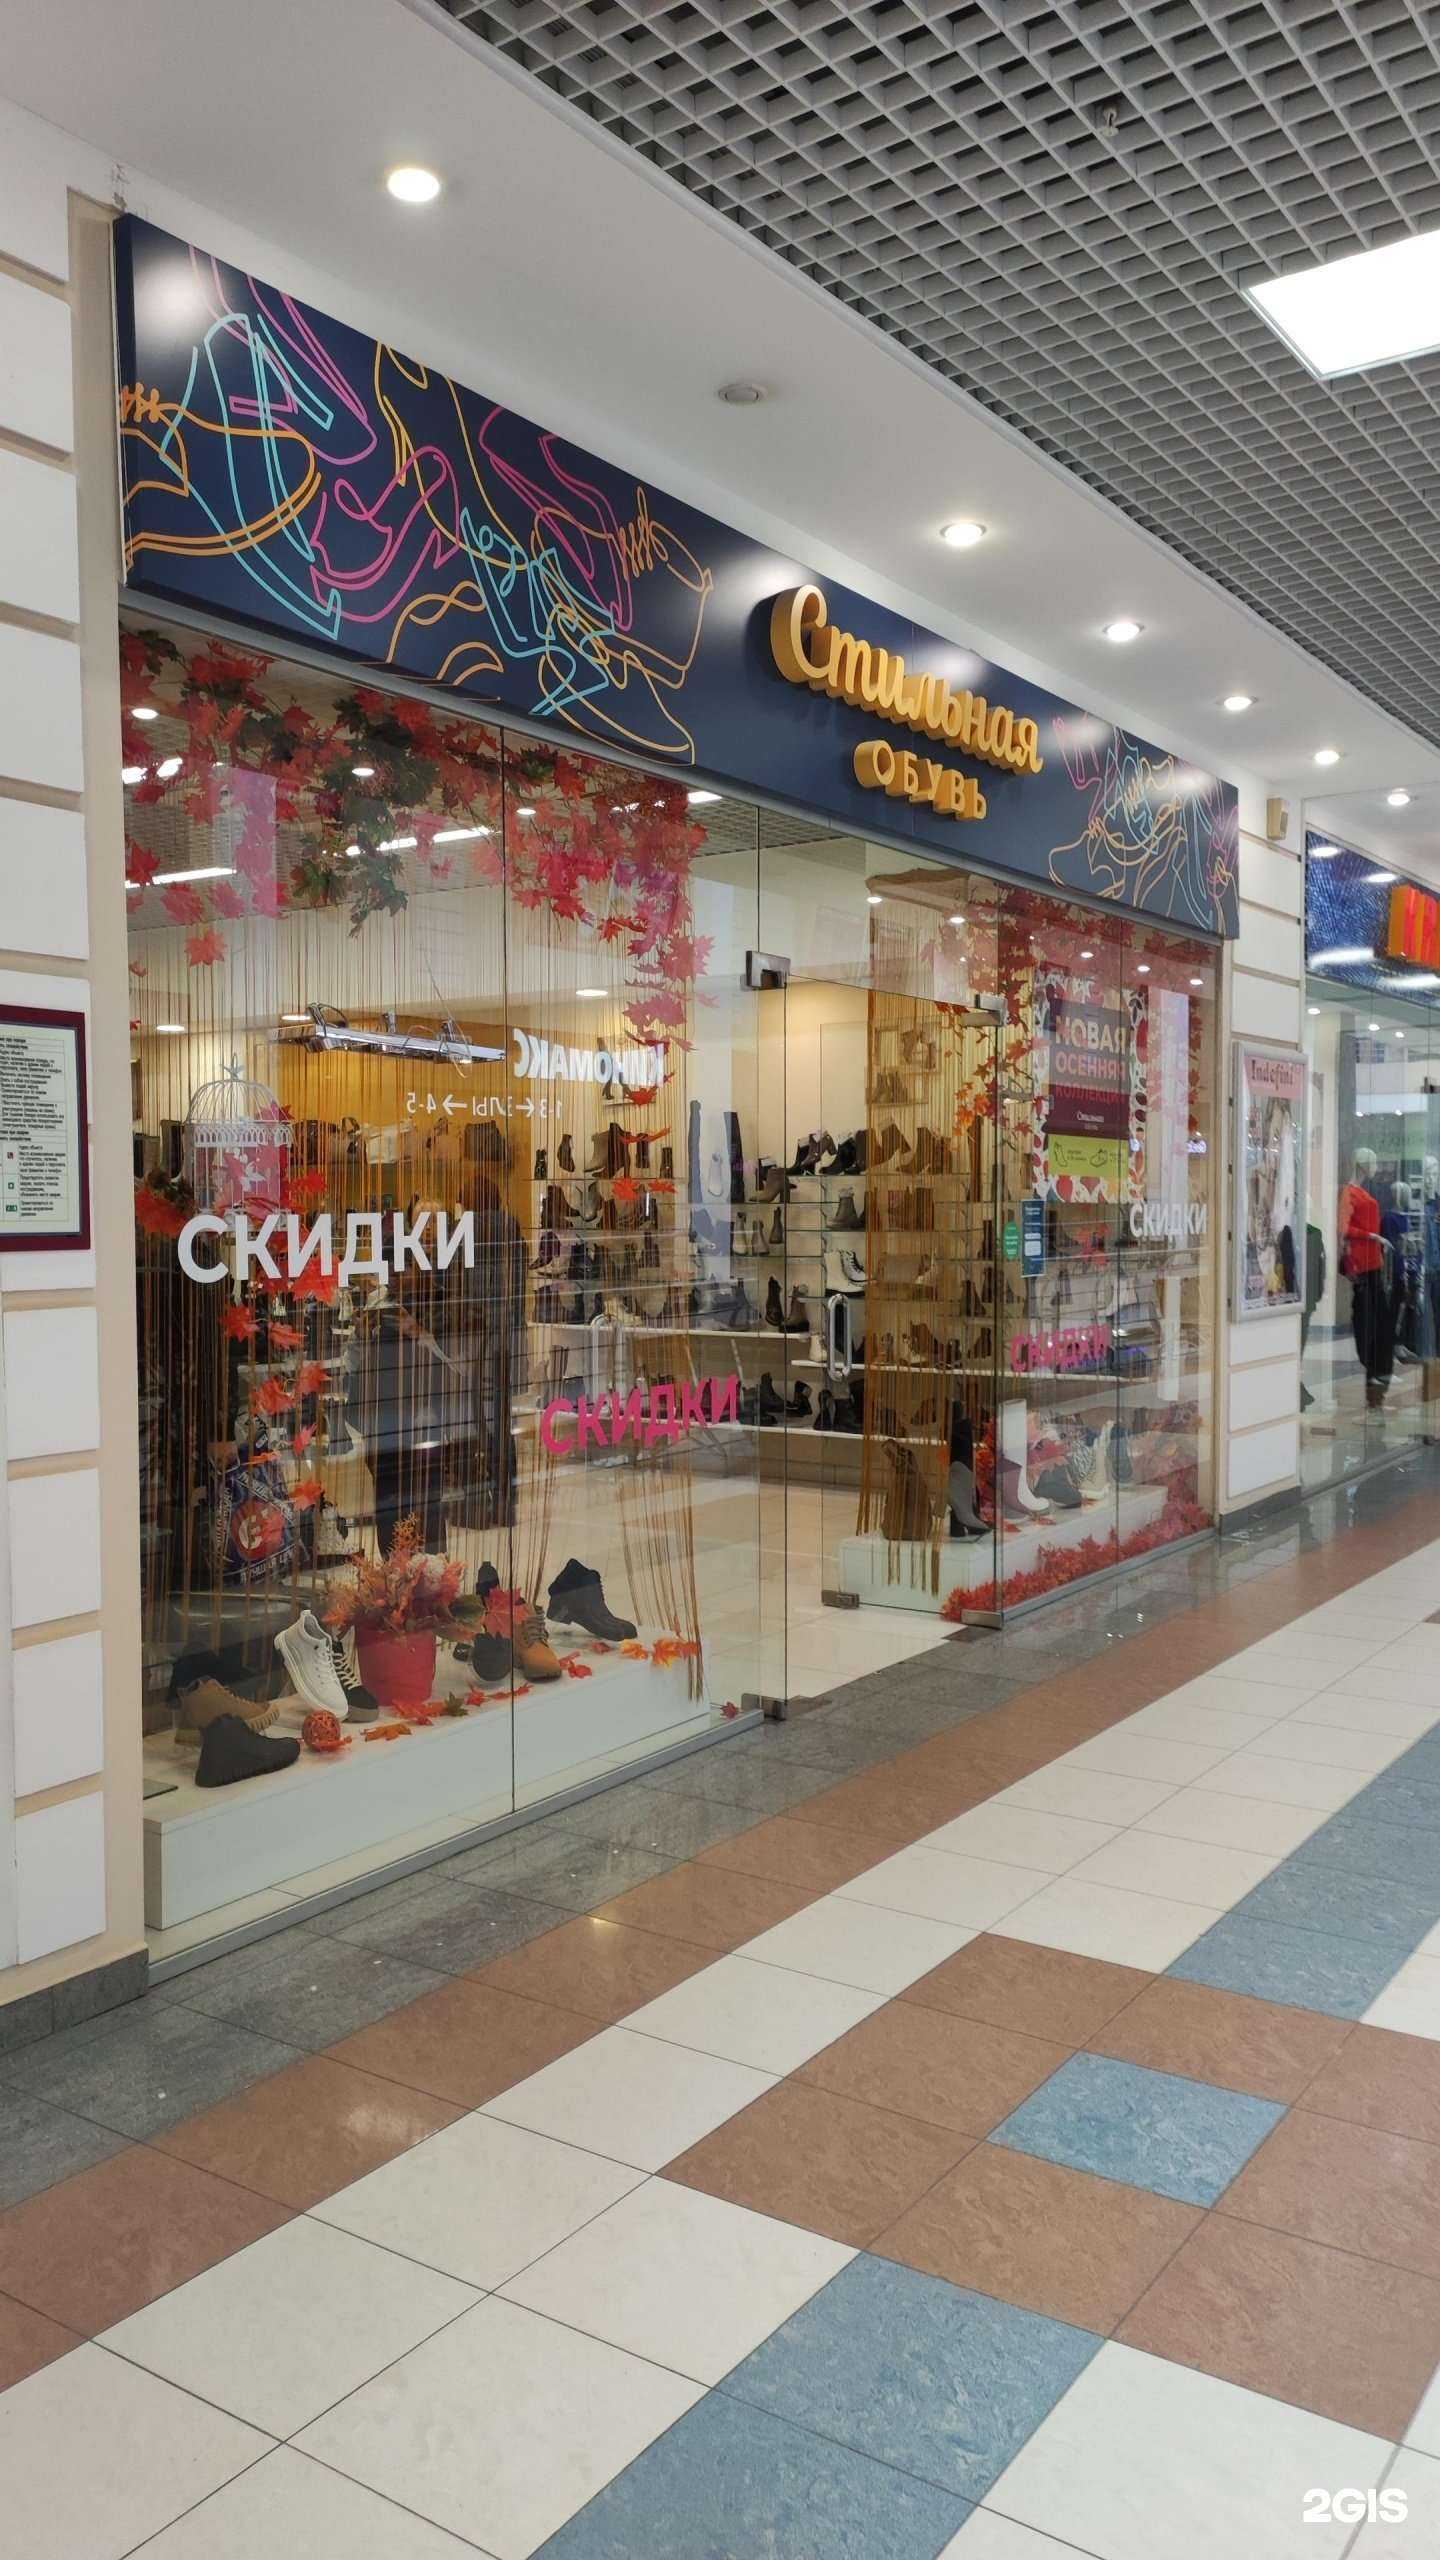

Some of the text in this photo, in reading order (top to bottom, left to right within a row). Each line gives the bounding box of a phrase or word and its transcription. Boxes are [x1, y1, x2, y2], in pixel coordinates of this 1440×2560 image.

[770, 584, 1044, 776] Стильная
[1055, 1015, 1128, 1056] НОВАЯ
[177, 1211, 475, 1288] СКИДКИ
[1129, 1203, 1207, 1243] СКИДКИ
[540, 1373, 740, 1455] СКИДКИ
